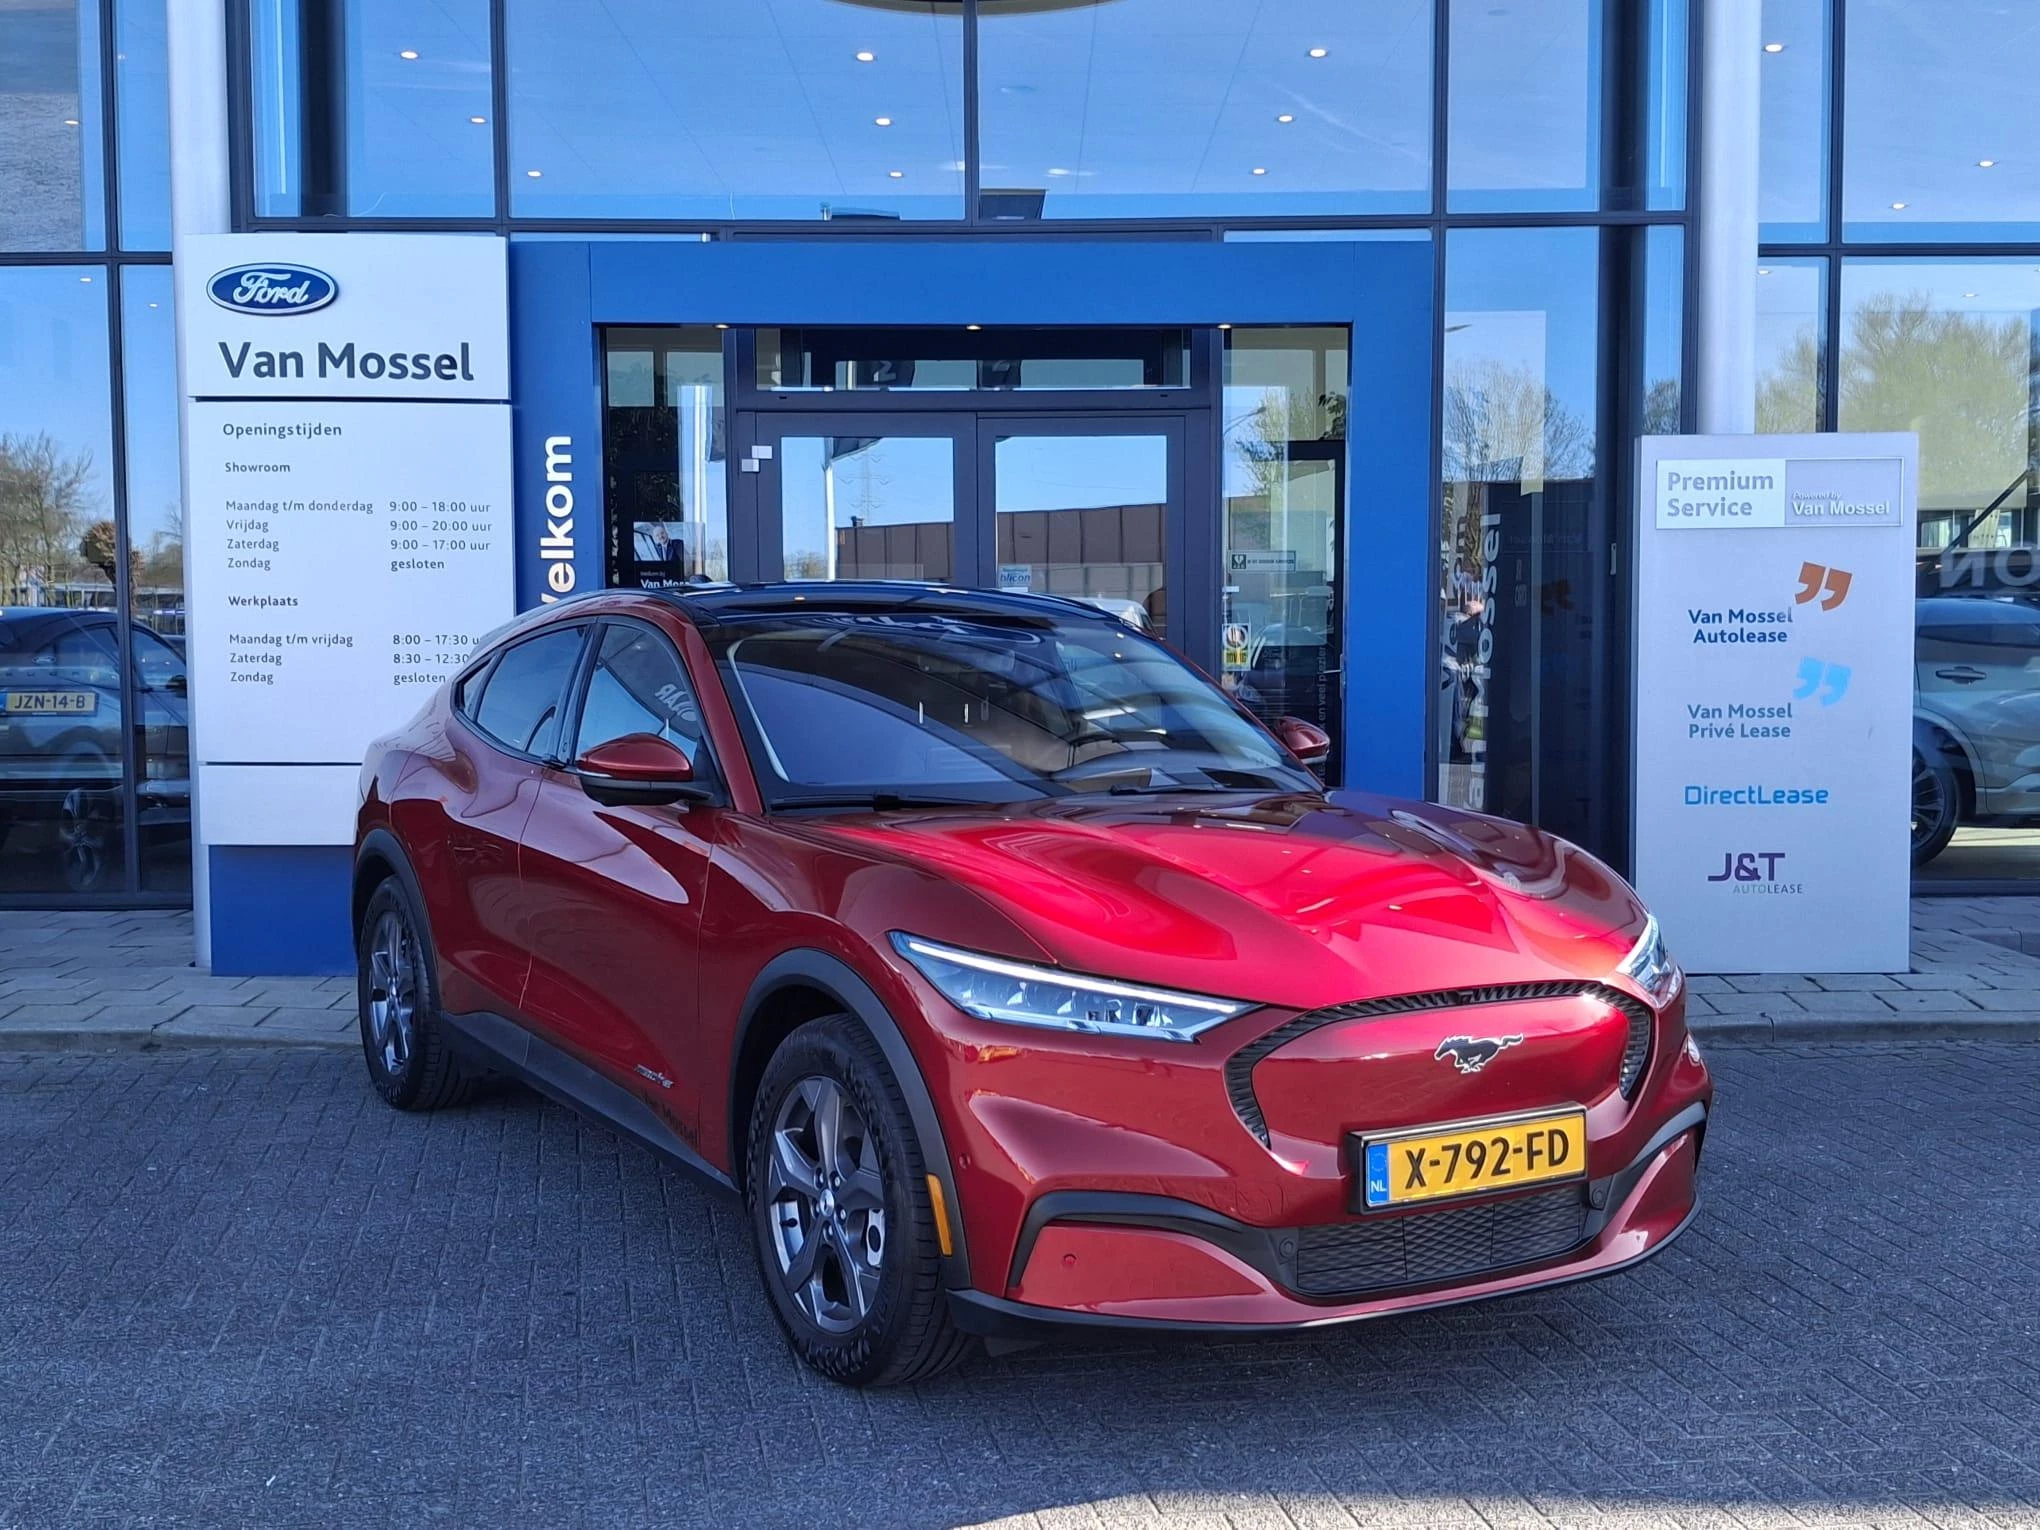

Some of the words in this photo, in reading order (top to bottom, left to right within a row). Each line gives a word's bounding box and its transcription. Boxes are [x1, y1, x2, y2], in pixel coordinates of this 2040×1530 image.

[233, 271, 310, 304] Ford
[218, 341, 304, 378] Van
[318, 342, 474, 381] Mossel
[223, 423, 342, 439] Openingstijden
[225, 462, 291, 473] Showroom
[1667, 470, 1773, 491] Premium
[226, 500, 279, 514] Maandag
[282, 500, 305, 512] t/m
[308, 500, 374, 514] donderdag
[389, 501, 418, 512] 9:00
[432, 501, 466, 513] 18:00
[470, 503, 491, 513] uur
[1667, 497, 1752, 517] Service
[1792, 500, 1824, 516] Van
[1829, 500, 1890, 516] Mossel
[226, 519, 269, 533] Vrijdag
[390, 521, 418, 532] 9:00
[432, 521, 468, 532] 20:00
[471, 523, 492, 532] uur
[227, 539, 280, 552] Zaterdag
[390, 539, 418, 551] 9:00
[433, 540, 466, 551] 17:00
[470, 542, 491, 551] uur
[227, 557, 271, 571] Zondag
[390, 559, 445, 572] gesloten
[228, 596, 299, 609] Werkplaats
[1688, 609, 1722, 624] Van
[1728, 607, 1793, 624] Mossel
[229, 633, 282, 647] Maandag
[286, 633, 308, 645] t/m
[311, 634, 353, 648] vrijdag
[392, 634, 421, 645] 8:00
[435, 634, 468, 645] 17:30
[472, 636, 480, 645] u
[1693, 628, 1787, 643] Autolease
[230, 653, 282, 666] Zaterdag
[393, 653, 421, 664] 8:30
[230, 672, 274, 685] Zondag
[393, 672, 446, 685] gesloten
[14, 695, 86, 709] JZN-14-B
[1687, 704, 1722, 719] Van
[1728, 703, 1793, 719] Mossel
[1689, 723, 1735, 739] Privé
[1741, 724, 1791, 738] Lease
[1684, 785, 1829, 805] DirectLease
[1707, 853, 1786, 882] J&T
[1733, 884, 1803, 894] AUTOLEASE
[1405, 1128, 1569, 1190] X-792-FD
[1371, 1180, 1387, 1192] NL
